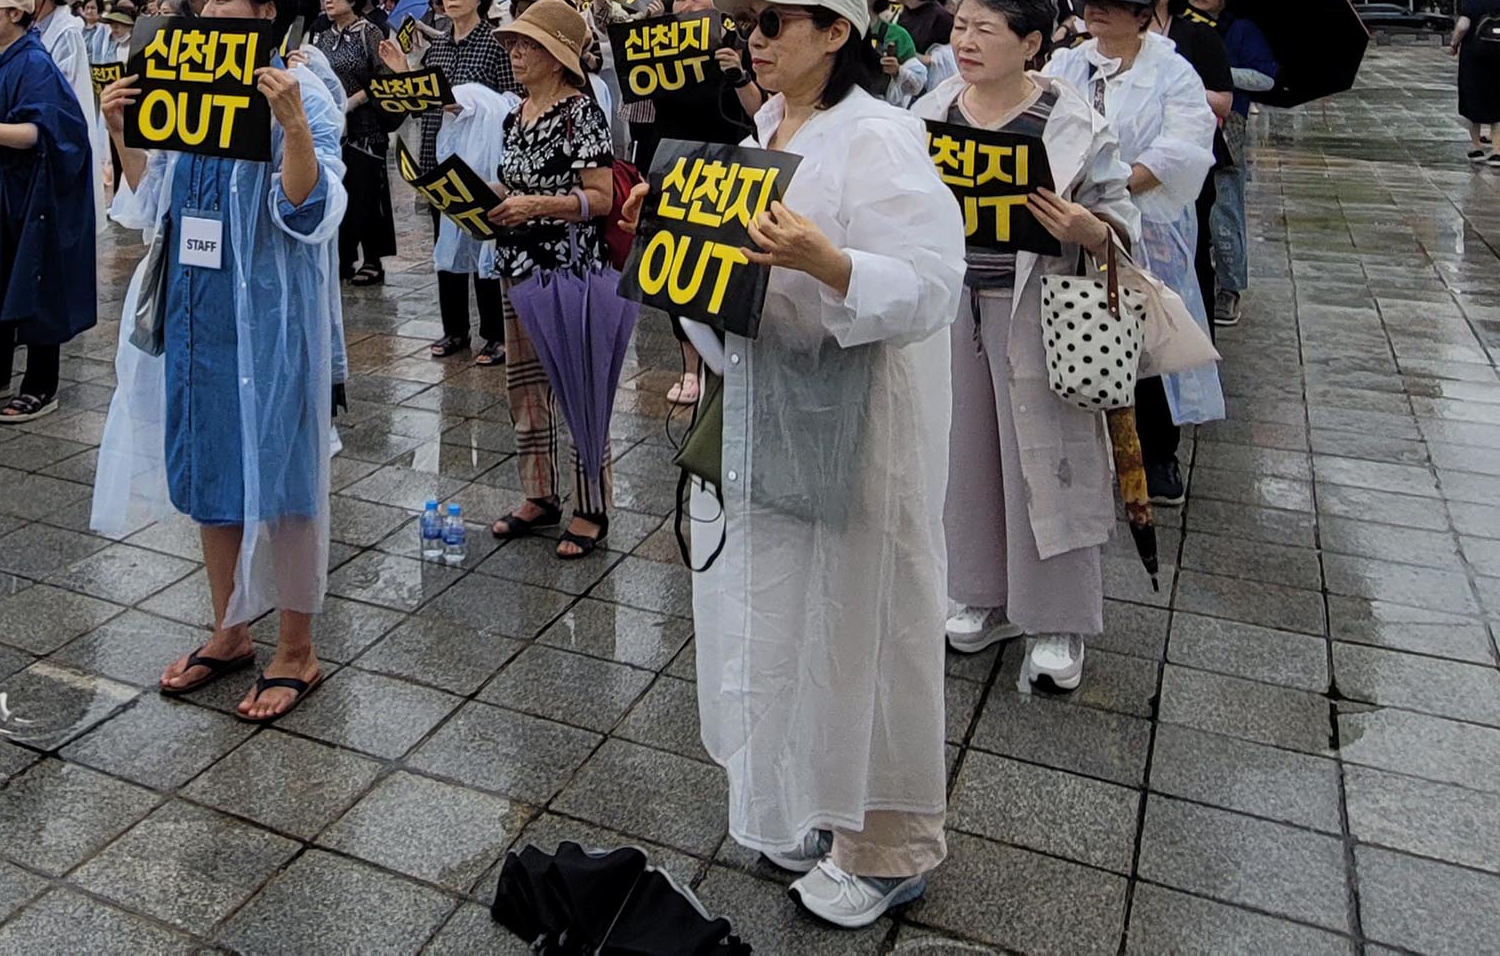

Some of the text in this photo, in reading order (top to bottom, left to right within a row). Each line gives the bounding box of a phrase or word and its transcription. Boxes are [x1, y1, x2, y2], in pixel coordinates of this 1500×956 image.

[144, 29, 259, 85] 신천지
[625, 17, 710, 61] 신천지
[369, 72, 440, 98] 신천지
[629, 55, 710, 96] OUT
[138, 88, 250, 148] OUT
[927, 133, 1029, 187] 천지
[657, 156, 780, 229] 신천지
[187, 238, 217, 252] STAFF
[638, 229, 749, 314] OUT
